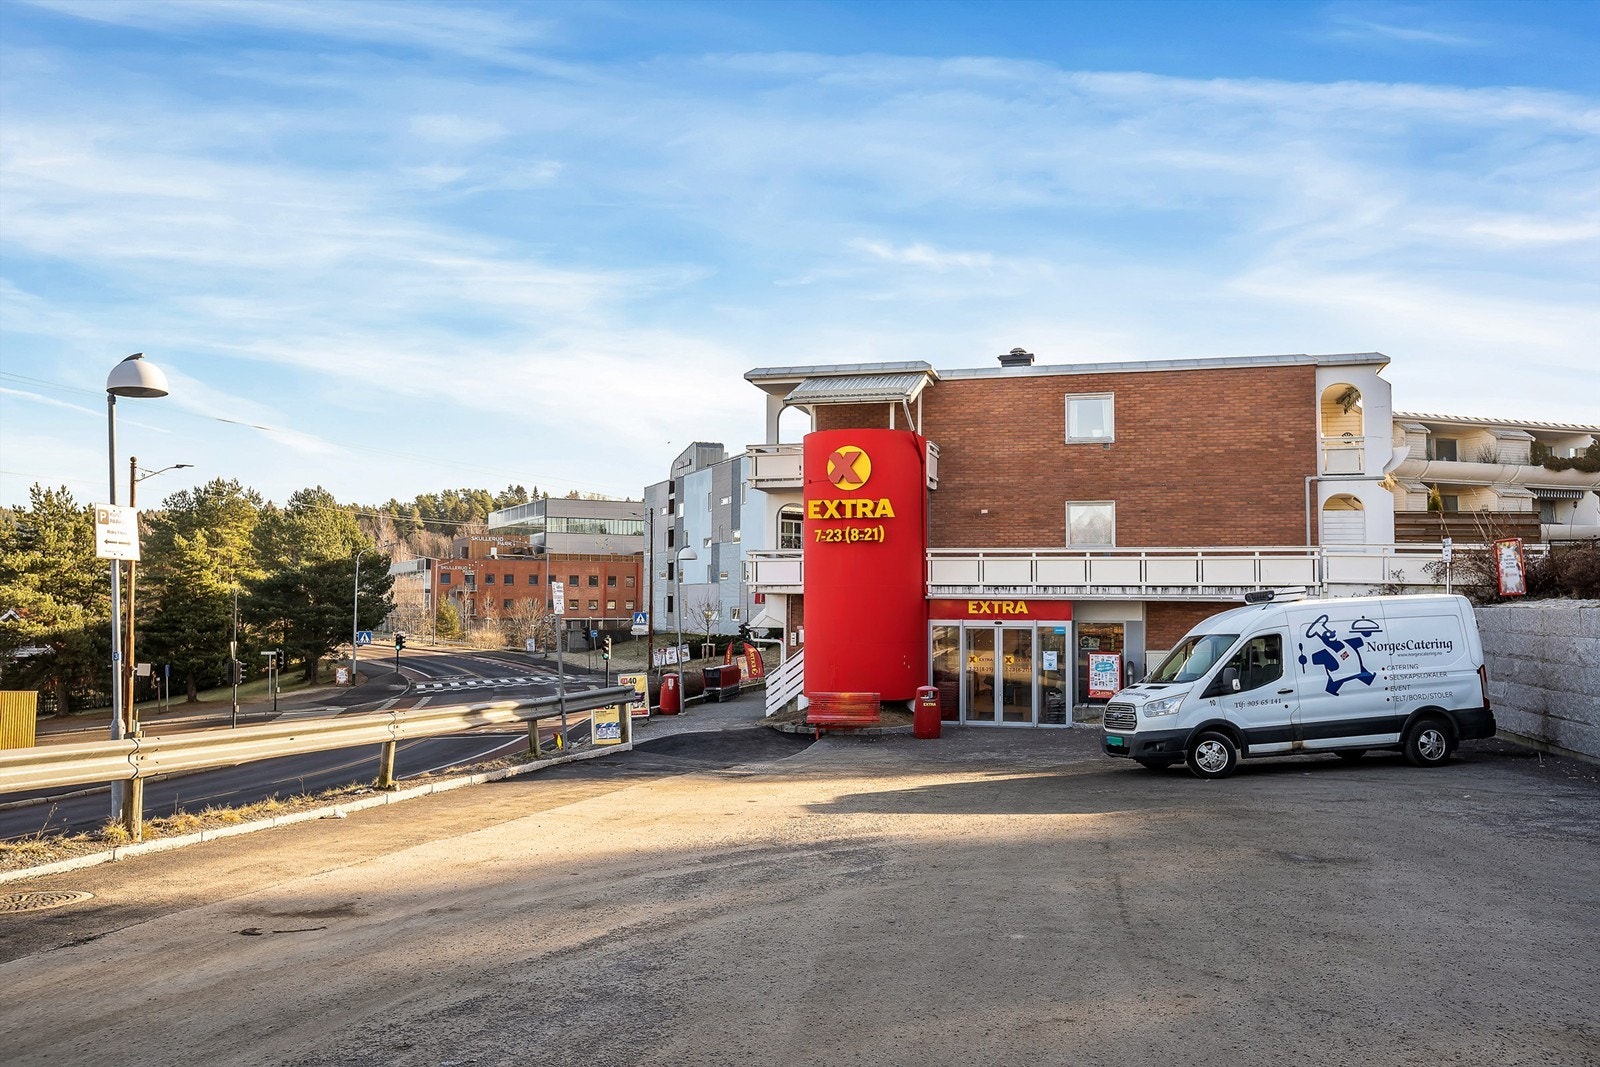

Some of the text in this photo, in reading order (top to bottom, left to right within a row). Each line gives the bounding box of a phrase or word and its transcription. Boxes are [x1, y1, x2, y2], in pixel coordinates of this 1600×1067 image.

[807, 498, 895, 519] EXTRA
[814, 525, 885, 543] 7-23 (8-21)
[968, 600, 1029, 614] EXTRA
[1366, 638, 1453, 656] NorgesCatering
[1386, 663, 1419, 671] CATERING
[1389, 671, 1448, 681] SELSKAPSLOKALER
[1390, 684, 1411, 692] EVENT
[1391, 692, 1454, 702] TELT/BORD/STOLER
